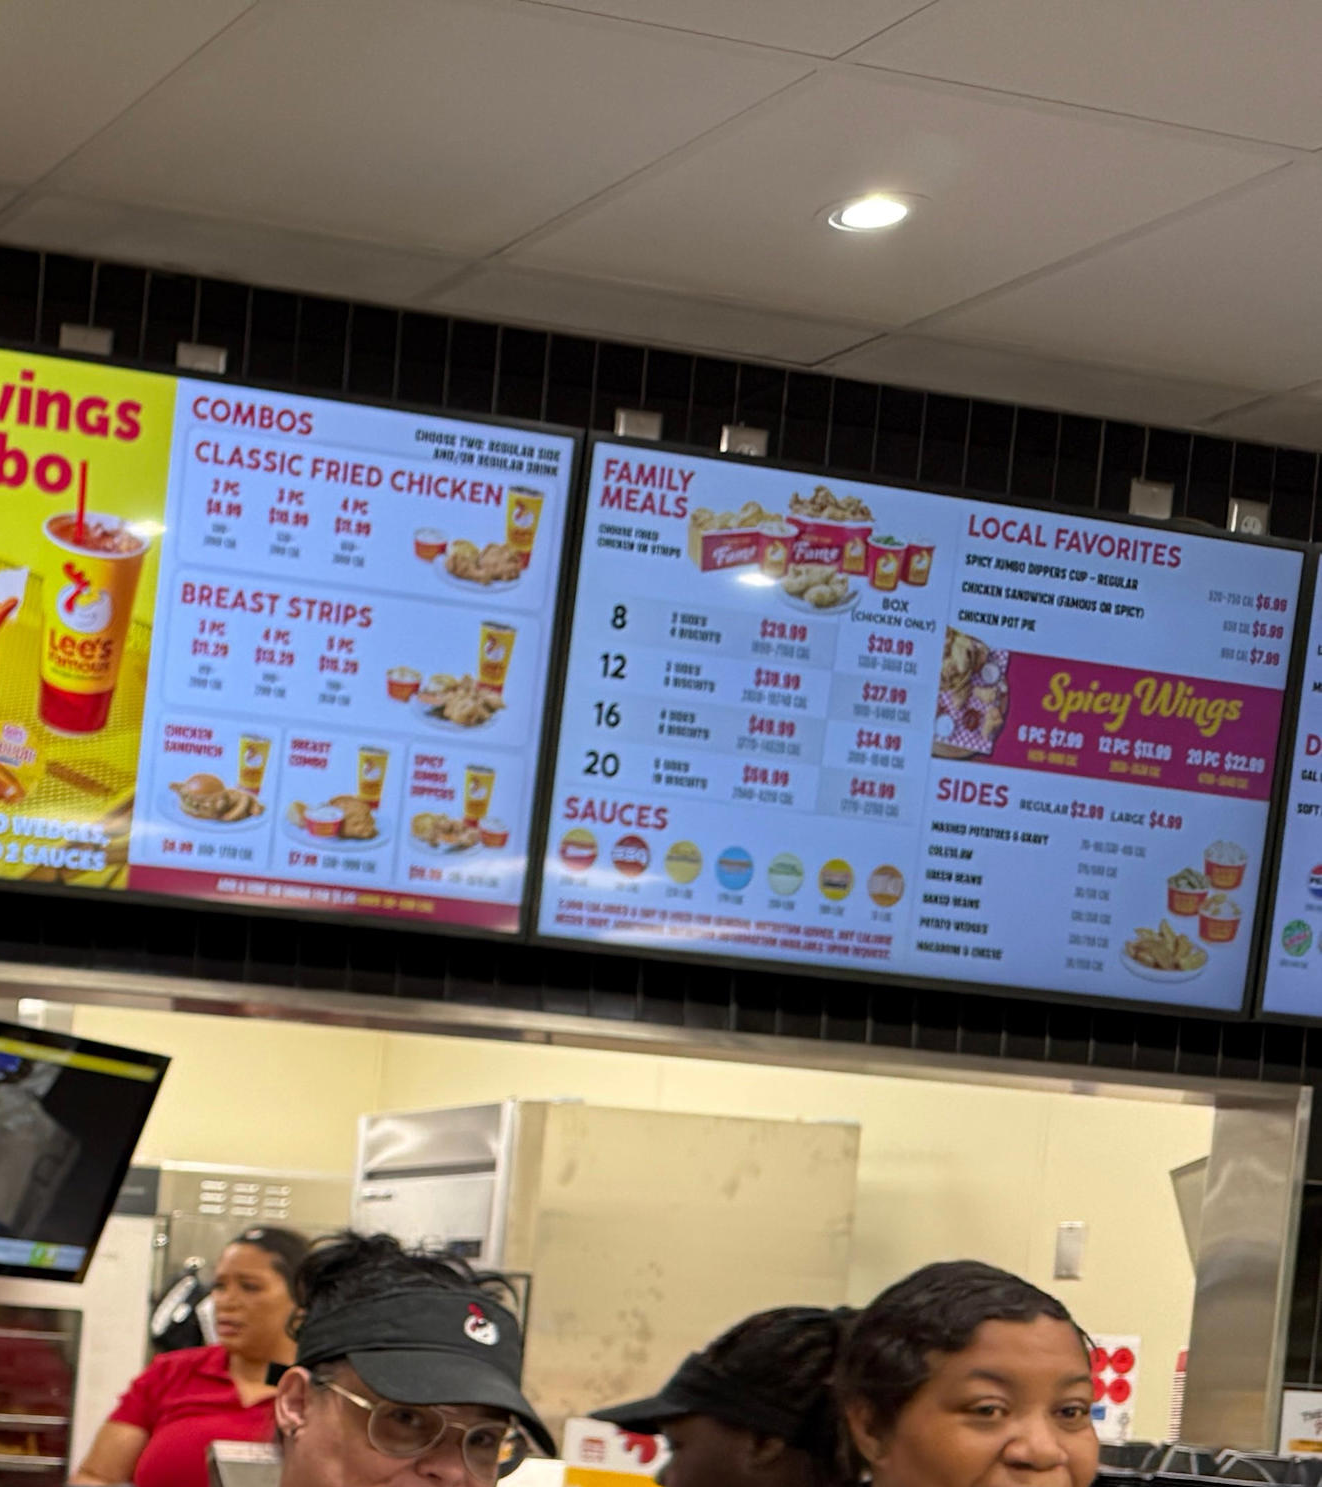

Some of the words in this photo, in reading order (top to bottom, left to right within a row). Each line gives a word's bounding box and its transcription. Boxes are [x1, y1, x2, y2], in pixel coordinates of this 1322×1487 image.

[192, 396, 313, 435] COMBOS
[415, 429, 456, 446] CHOOSE
[488, 441, 535, 459] REGULAR
[195, 441, 303, 476] CLASSIC
[311, 457, 383, 488] FRIED
[391, 470, 504, 507] CHICKEN
[478, 454, 524, 472] REGULAR
[526, 462, 559, 477] DRINK
[604, 459, 695, 492] FAMILY
[600, 486, 688, 518] MEALS
[968, 514, 1047, 548] LOCAL
[1054, 528, 1182, 568] FAVORITES
[965, 553, 993, 570] SPICY
[994, 558, 1025, 574] JUMBO
[1028, 562, 1066, 580] DIPPERS
[1069, 569, 1088, 582] CUP
[1097, 573, 1139, 591] REGULAR
[181, 583, 281, 616] BREAST
[287, 597, 373, 629] STRIPS
[882, 597, 909, 613] BOX
[962, 581, 1002, 598] CHICKEN
[1005, 588, 1055, 606] SANDWICH
[1057, 594, 1097, 612] (FAMOUS
[1099, 601, 1112, 615] OR
[1115, 604, 1145, 619] SPICY)
[611, 604, 627, 630] 8
[851, 608, 902, 628] (CHICKEN
[906, 618, 937, 634] ONLY)
[958, 610, 999, 626] CHICKEN
[1001, 615, 1020, 629] POT
[1021, 619, 1037, 632] PIE
[600, 653, 627, 680] 12
[594, 702, 621, 728] 16
[1042, 672, 1132, 733] Spicy
[1133, 677, 1244, 737] Wings
[1028, 727, 1046, 745] PC
[1112, 738, 1130, 756] PC
[583, 750, 620, 778] 20
[1204, 750, 1221, 768] PC
[564, 796, 668, 830] SAUCES
[937, 777, 1009, 808] SIDES
[1019, 799, 1069, 815] REGULAR
[1110, 810, 1146, 826] LARGE
[5, 842, 19, 863] 2
[23, 845, 108, 870] SAUCES
